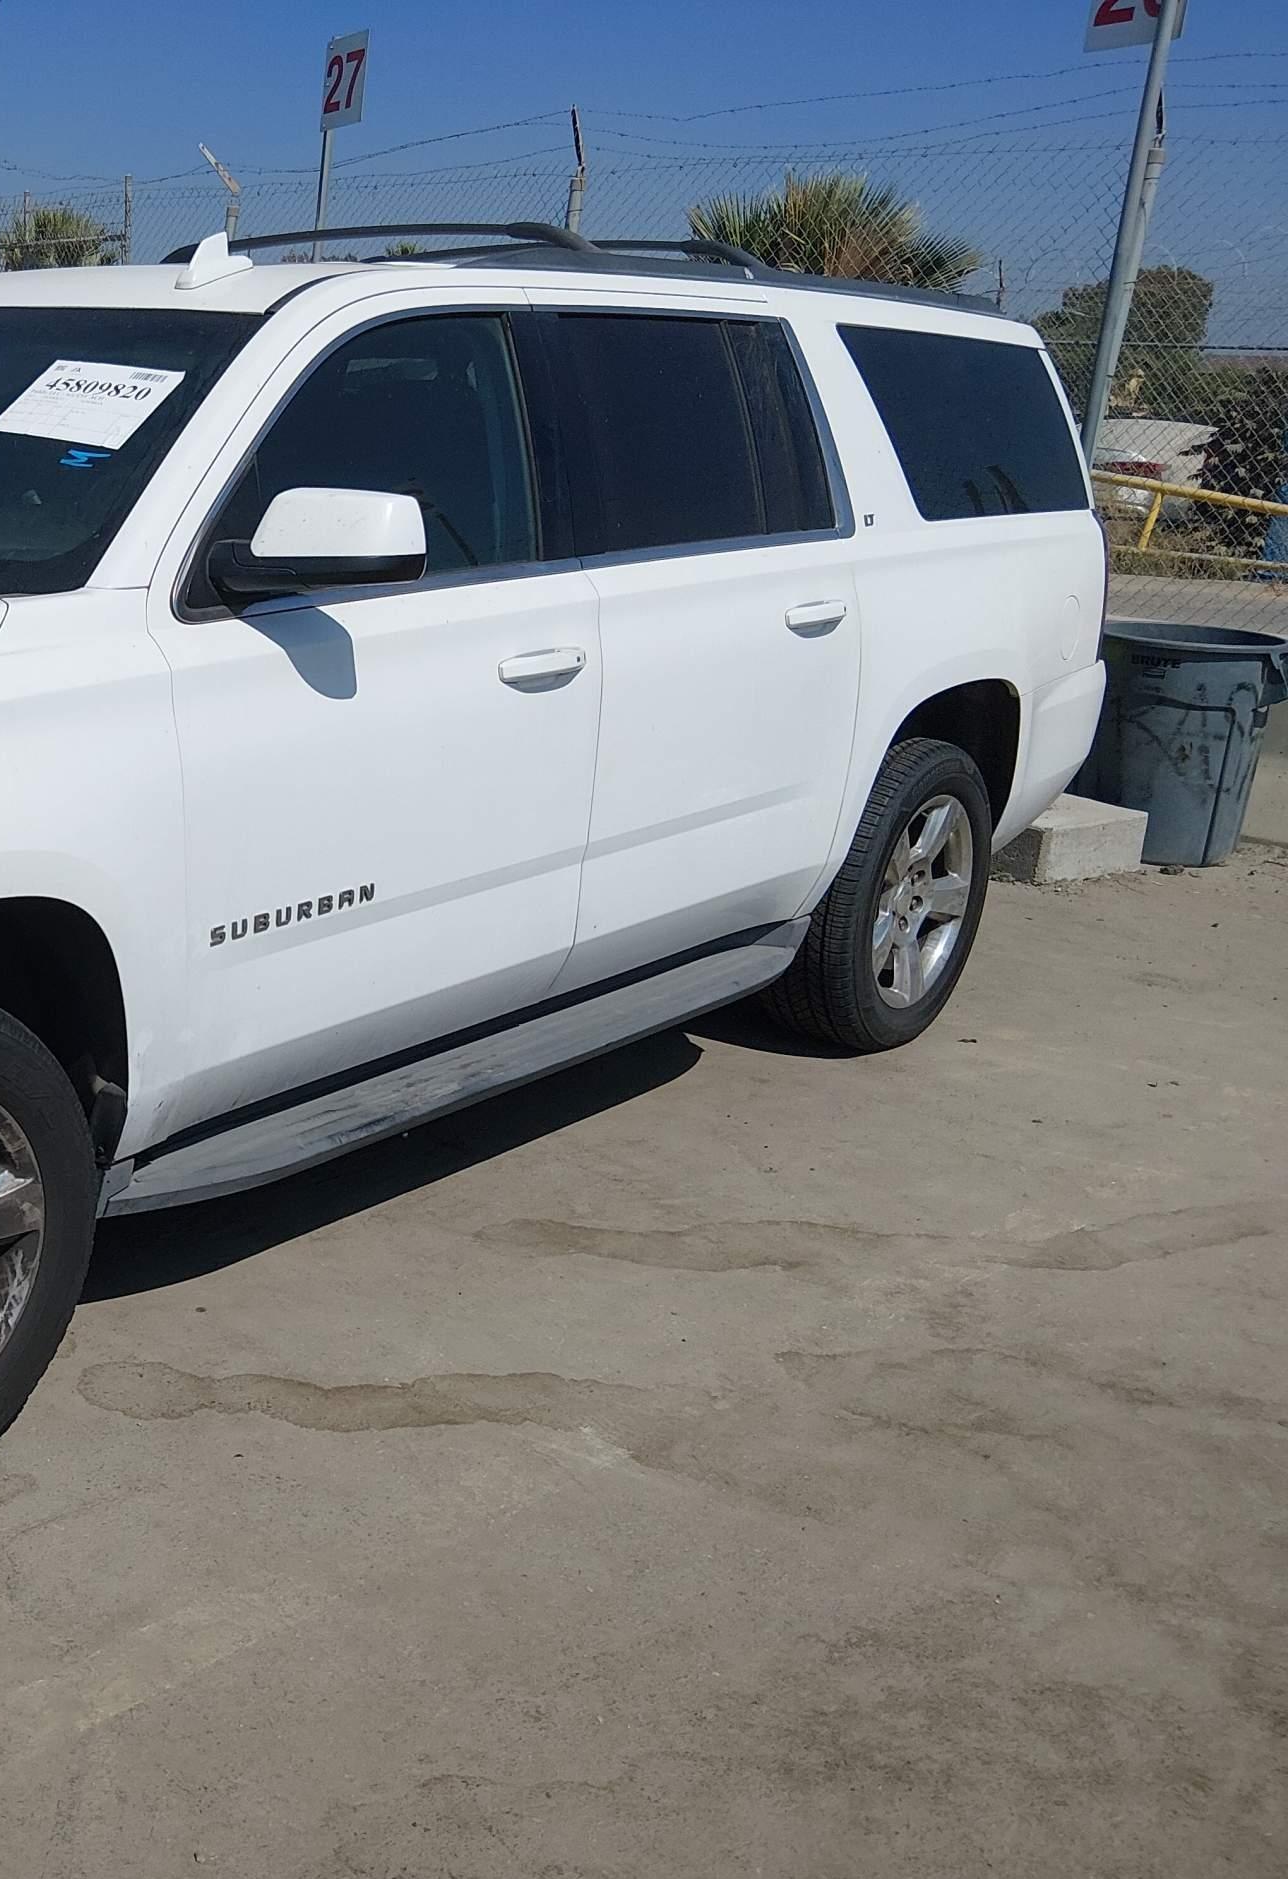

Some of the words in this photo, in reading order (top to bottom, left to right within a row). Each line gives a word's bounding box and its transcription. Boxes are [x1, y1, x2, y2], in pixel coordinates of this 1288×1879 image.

[323, 48, 365, 114] 27
[45, 377, 152, 401] 45809820
[210, 883, 375, 947] SUBURBAN
